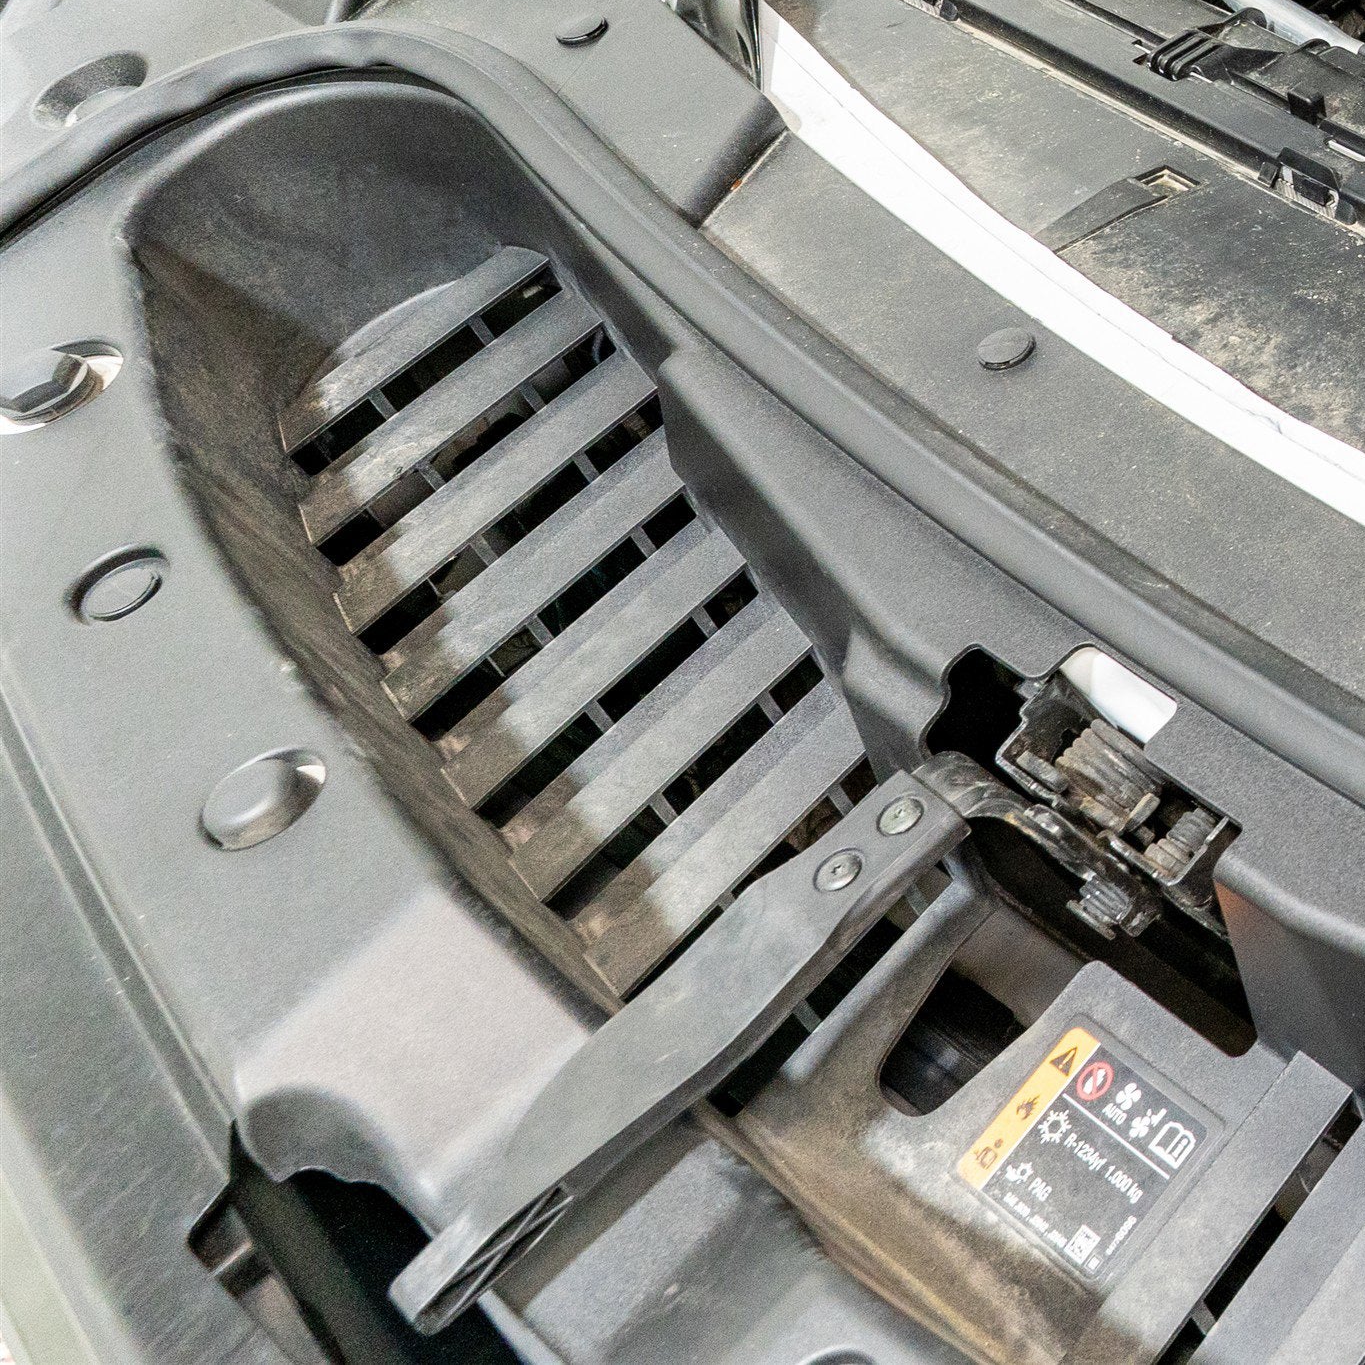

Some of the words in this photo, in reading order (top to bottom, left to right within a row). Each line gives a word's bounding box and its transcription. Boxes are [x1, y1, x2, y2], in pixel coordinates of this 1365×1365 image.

[1102, 1103, 1126, 1124] AUTO
[1064, 1133, 1106, 1170] R-1234yf
[1105, 1165, 1132, 1191] 1.000
[1126, 1183, 1142, 1203] kg
[1028, 1177, 1051, 1201] PAG
